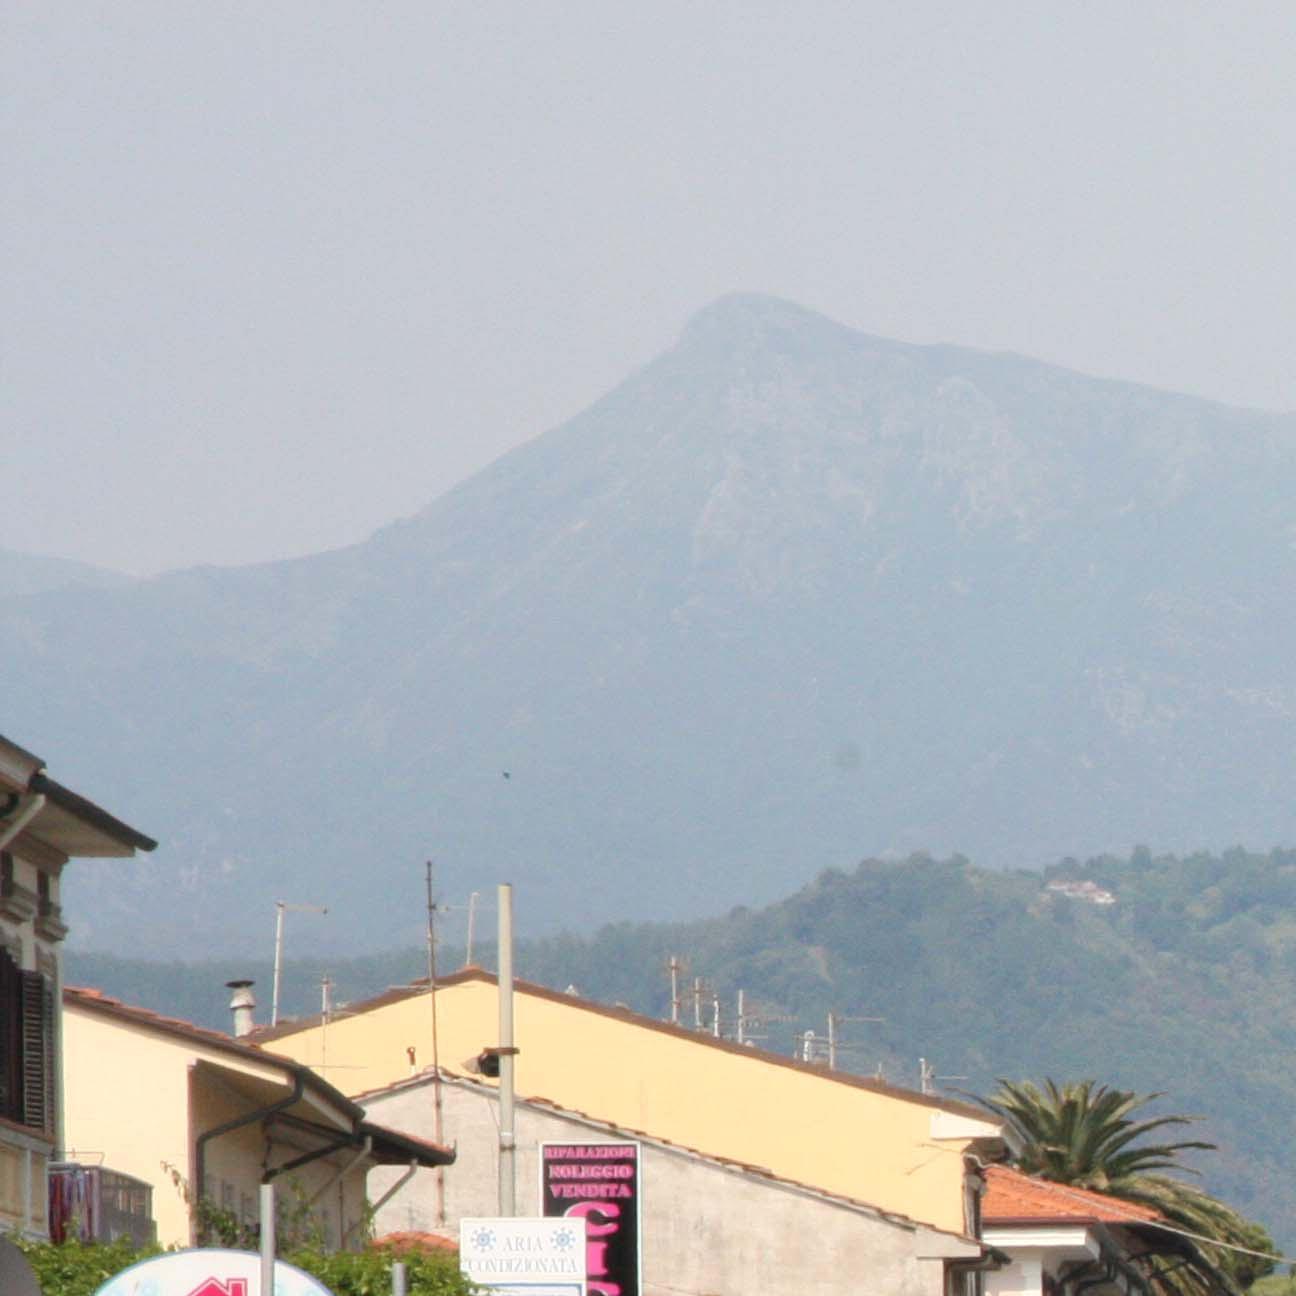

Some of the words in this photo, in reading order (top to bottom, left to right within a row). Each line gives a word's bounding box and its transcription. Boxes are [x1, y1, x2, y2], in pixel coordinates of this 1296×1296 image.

[549, 1164, 634, 1179] NOLEGGIO
[550, 1183, 633, 1198] VENDITA
[503, 1236, 543, 1251] ARIA
